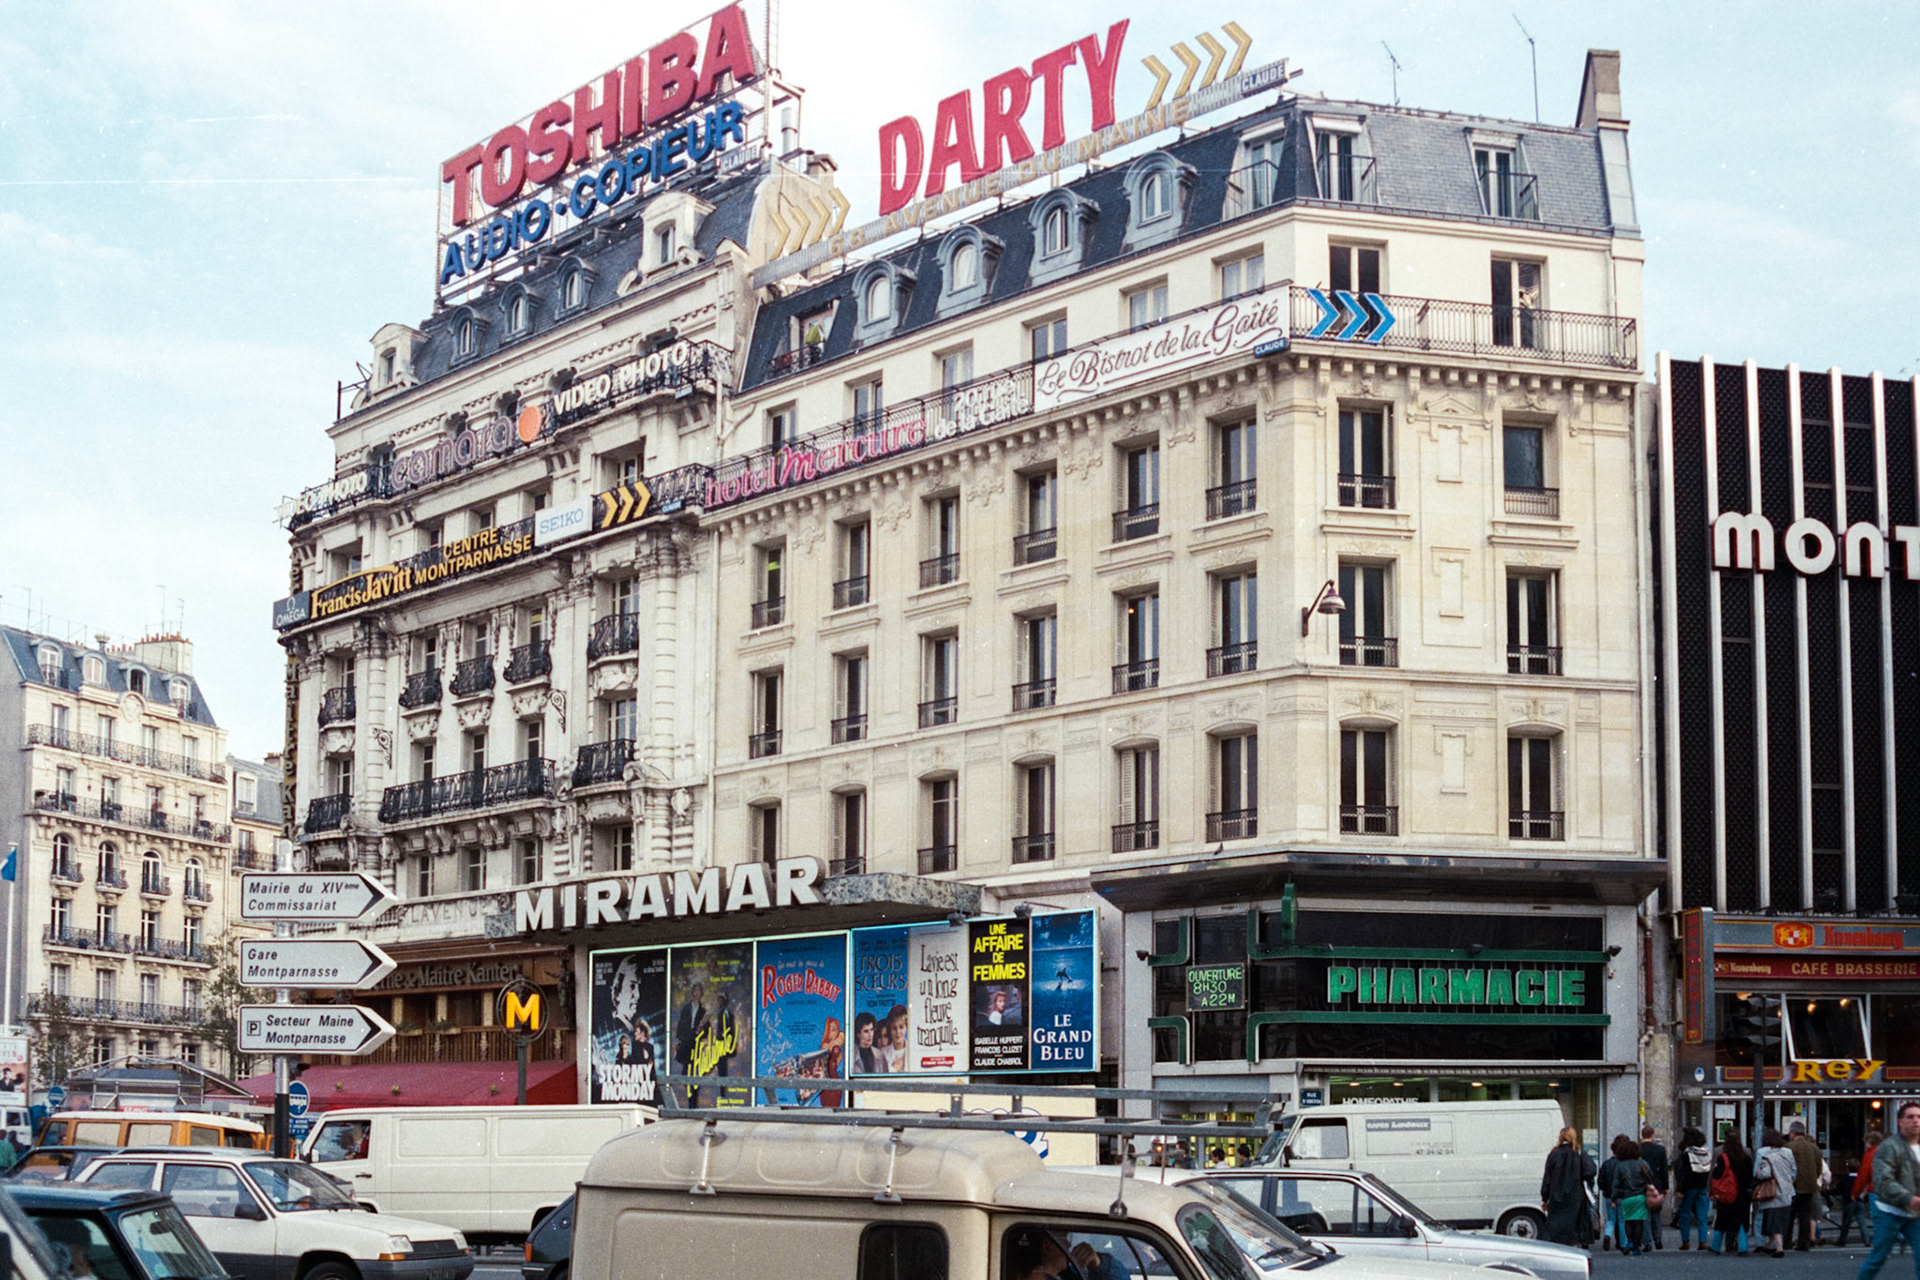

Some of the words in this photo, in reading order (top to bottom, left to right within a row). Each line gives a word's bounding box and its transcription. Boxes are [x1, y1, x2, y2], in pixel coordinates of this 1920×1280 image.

[1242, 64, 1285, 91] CLAUDE
[443, 3, 756, 228] TOSHIBA
[878, 18, 1130, 216] DARTY
[570, 101, 744, 219] COPIEUR
[884, 174, 1001, 237] AVENUE
[1021, 152, 1060, 184] DU
[1079, 98, 1190, 162] MAINE
[1037, 362, 1065, 395] Le
[1069, 344, 1152, 388] Bistrot
[1154, 330, 1180, 359] de
[1182, 324, 1202, 348] la
[1202, 299, 1279, 355] Gaîté
[1255, 339, 1285, 355] CLAUDE
[554, 373, 611, 415] VIDEO
[618, 341, 688, 391] PHOTO
[934, 418, 957, 439] de
[704, 456, 776, 508] hotel
[539, 507, 585, 537] SEIKO
[443, 527, 498, 558] CENTRE
[415, 534, 532, 585] MONTPARNASSE
[310, 588, 361, 619] Francis
[361, 566, 412, 603] Javitt
[276, 607, 306, 627] OMEGA
[249, 882, 290, 894] Mairie
[298, 882, 313, 894] du
[515, 856, 826, 932] MIRAMAR
[249, 899, 337, 911] Commissariat
[989, 923, 1007, 935] UNE
[974, 934, 1024, 953] AFFAIRE
[248, 949, 277, 960] Gare
[859, 953, 903, 972] TROIS
[992, 952, 1004, 964] DE
[248, 966, 339, 979] Montparnasse
[467, 962, 519, 983] Kanter
[973, 962, 1025, 981] FEMMES
[1188, 967, 1242, 982] OUVERTURE
[1792, 961, 1828, 975] CAFÉ
[1835, 962, 1917, 976] BRASSERIE
[761, 965, 804, 1008] ROGER
[804, 968, 841, 1002] RABBIT
[920, 979, 933, 996] un
[935, 973, 958, 999] long
[1193, 981, 1227, 995] 8H30
[1327, 966, 1585, 1006] PHARMACIE
[924, 997, 951, 1023] fleuve
[1201, 997, 1208, 1007] A
[1209, 993, 1236, 1006] 22H
[506, 991, 540, 1030] M
[1054, 1014, 1072, 1027] LE
[249, 1022, 258, 1034] P
[266, 1015, 311, 1026] Secteur
[319, 1015, 354, 1027] Maine
[266, 1032, 346, 1046] Montparnasse
[917, 1019, 959, 1051] tranquille
[975, 1037, 998, 1045] ISABELLE
[999, 1036, 1023, 1044] HUPPERT
[1033, 1028, 1092, 1044] GRAND
[1041, 1045, 1084, 1060] BLEU
[599, 1063, 653, 1083] STORMY
[601, 1081, 656, 1100] MONDAY
